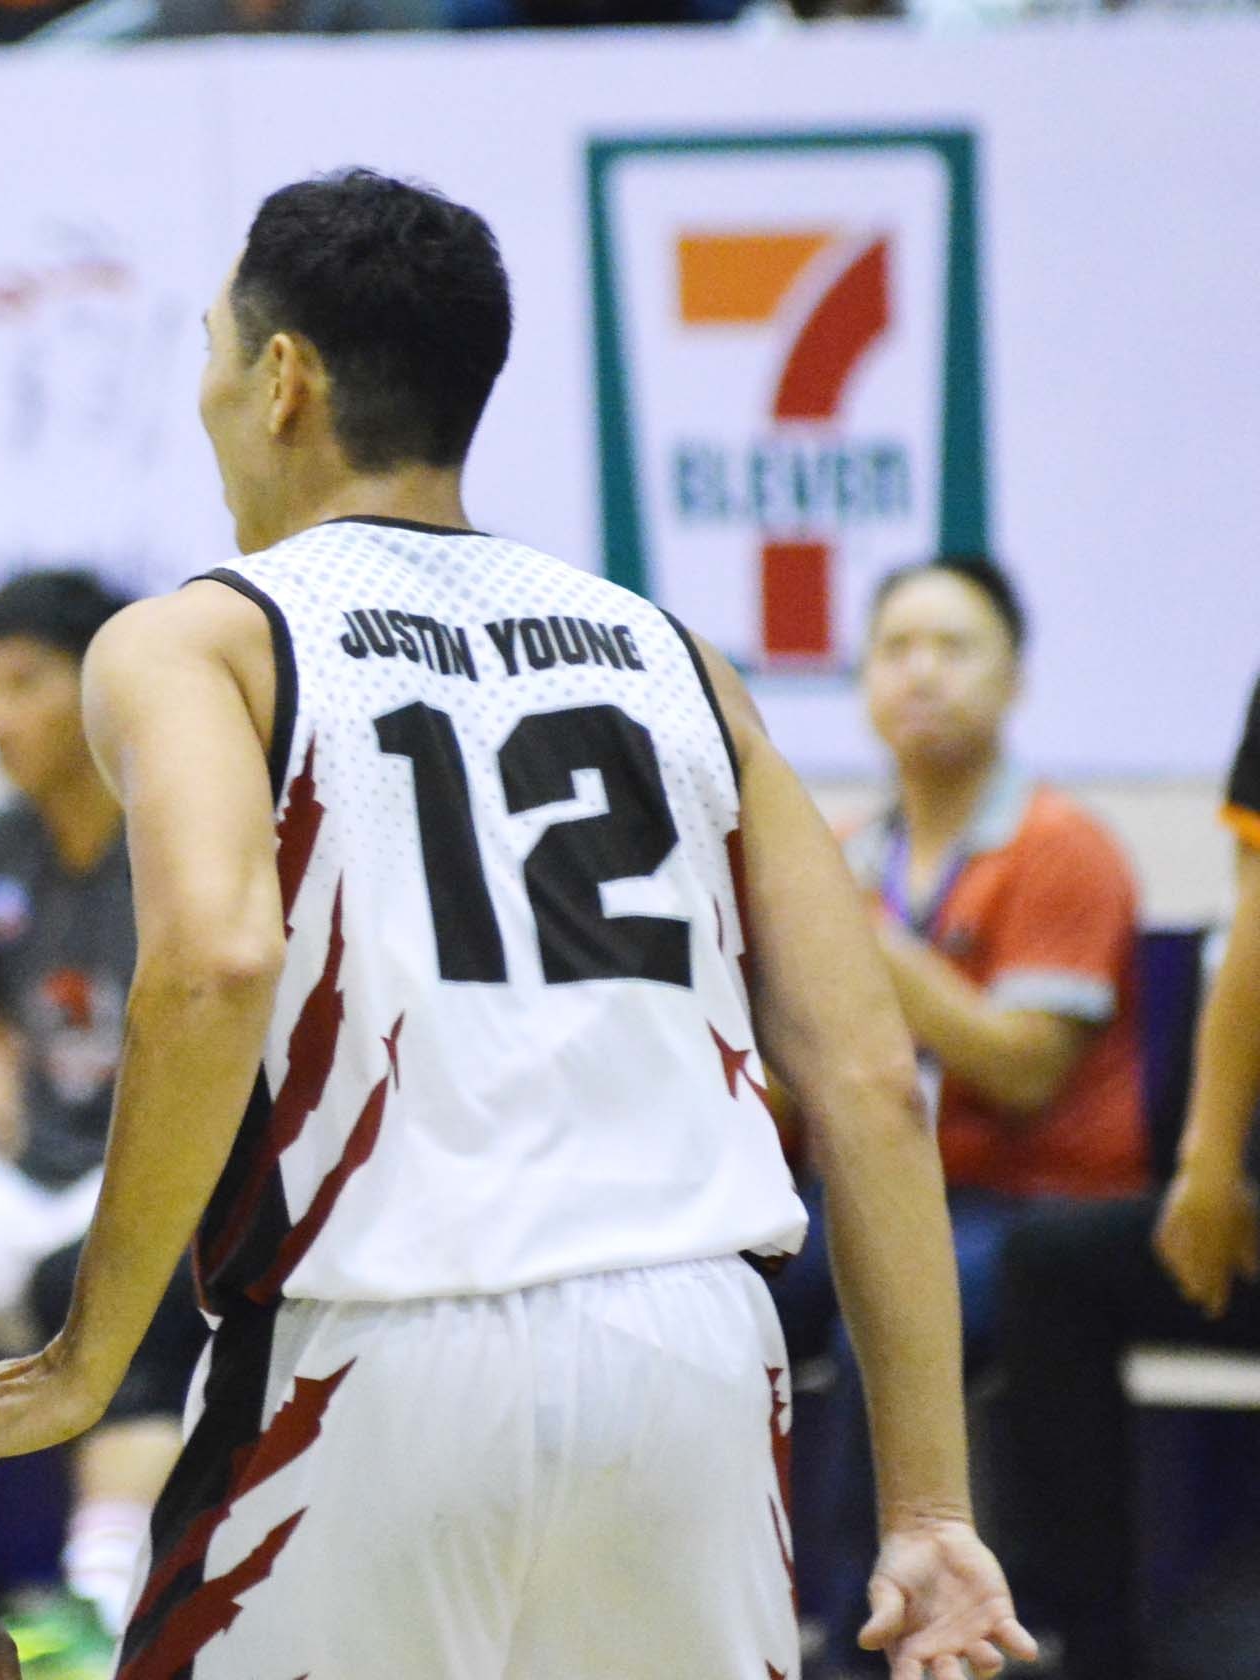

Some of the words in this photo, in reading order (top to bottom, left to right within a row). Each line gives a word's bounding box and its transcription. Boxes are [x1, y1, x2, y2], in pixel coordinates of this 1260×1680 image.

[675, 228, 893, 658] 7
[340, 608, 479, 682] JUSTIN
[483, 614, 648, 677] YOUNG
[372, 700, 694, 989] 12
